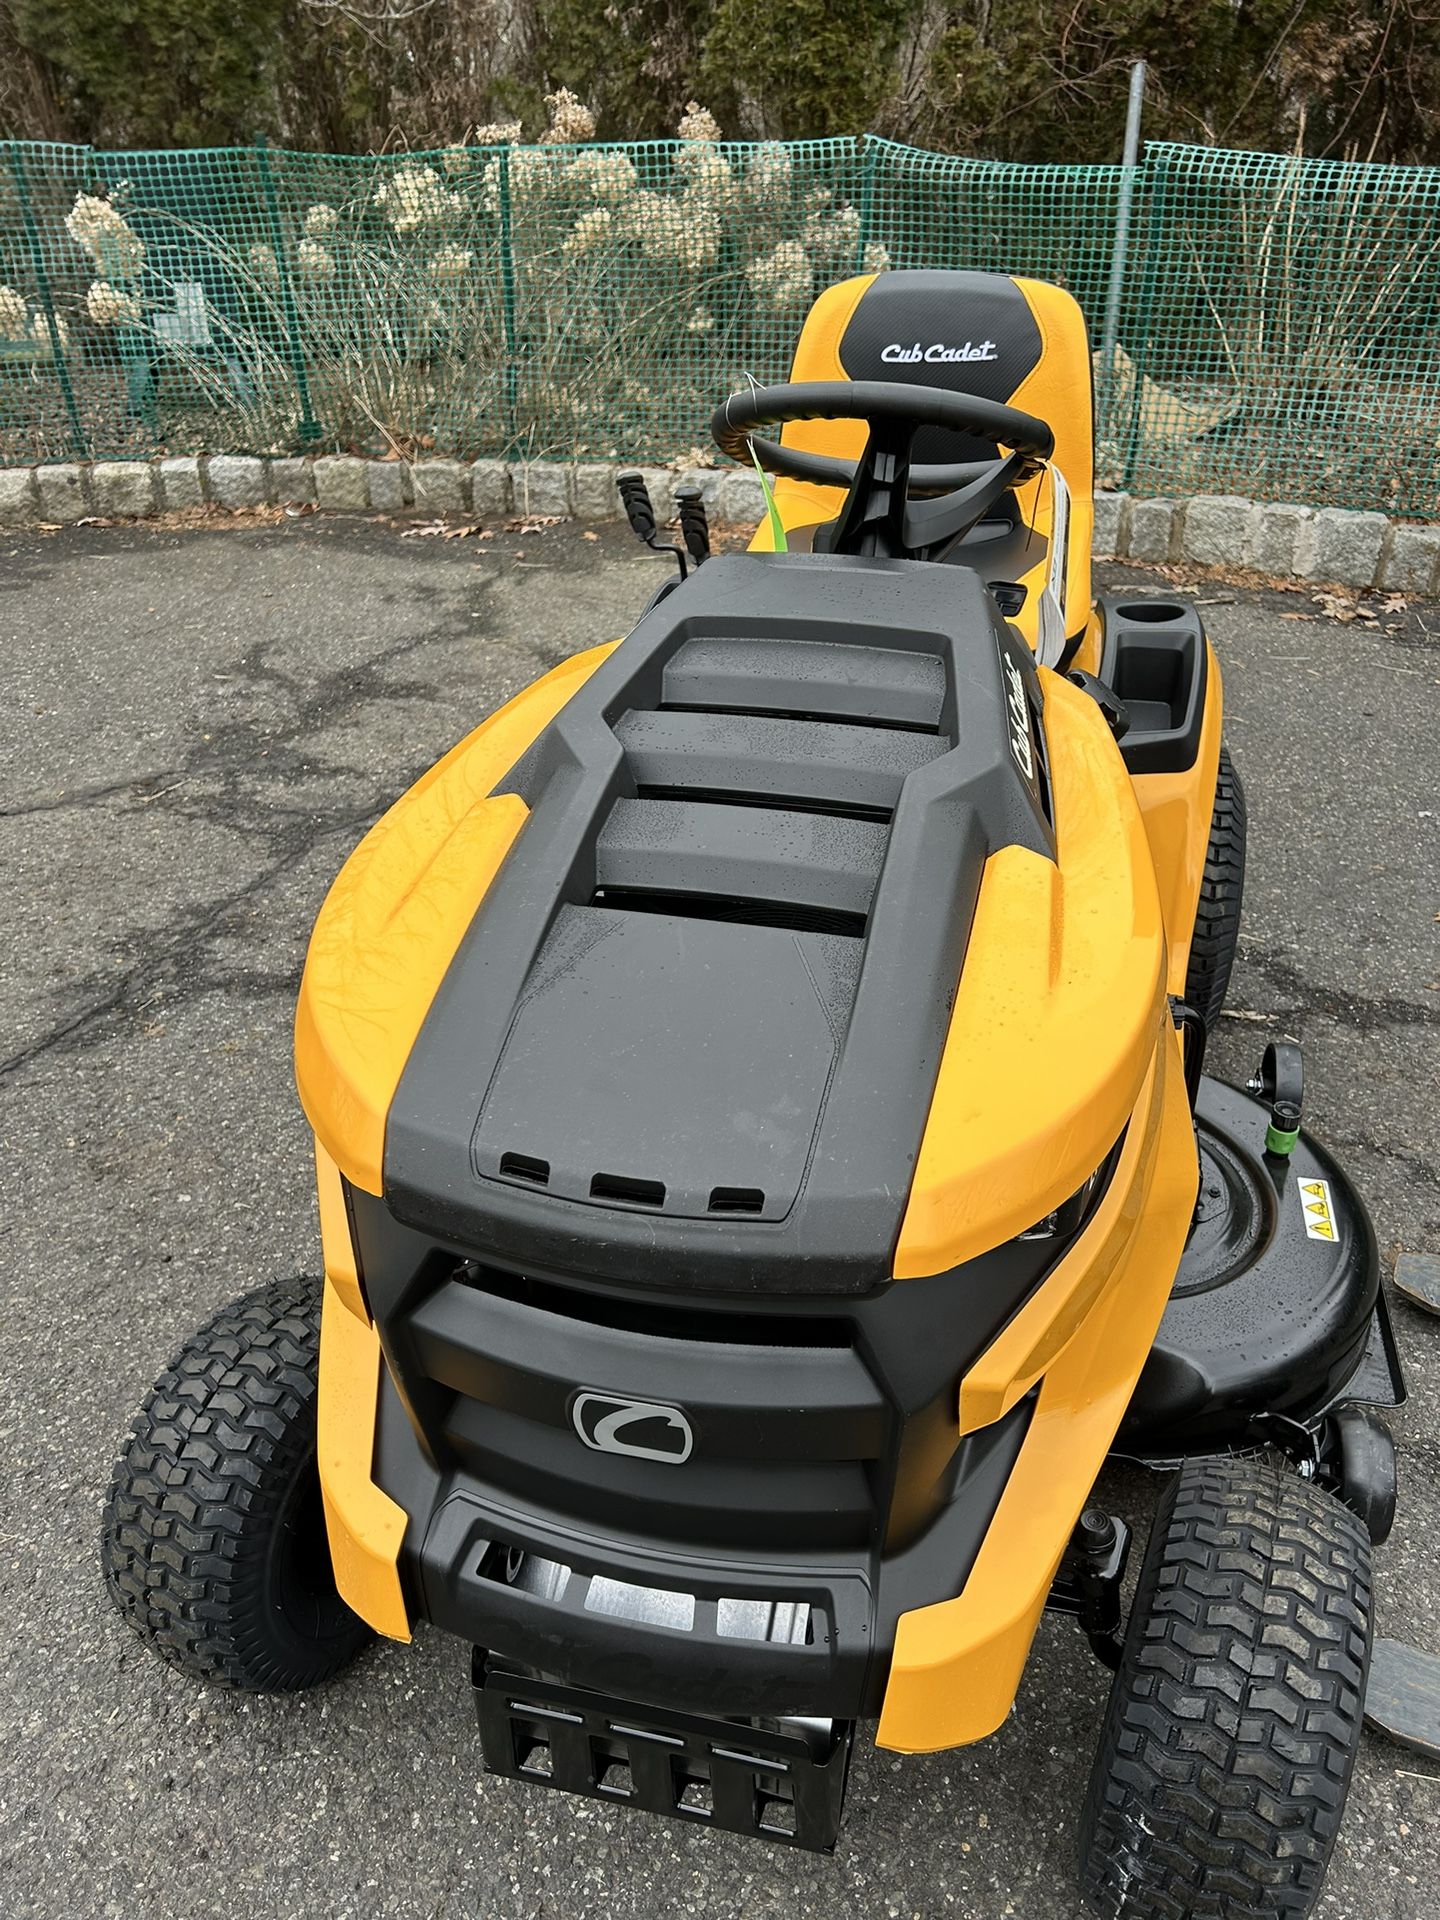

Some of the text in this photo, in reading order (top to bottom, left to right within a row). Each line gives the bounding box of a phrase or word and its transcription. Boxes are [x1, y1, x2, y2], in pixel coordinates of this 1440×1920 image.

[881, 341, 998, 362] Cub Cadet
[1004, 651, 1034, 780] Cub Cadet
